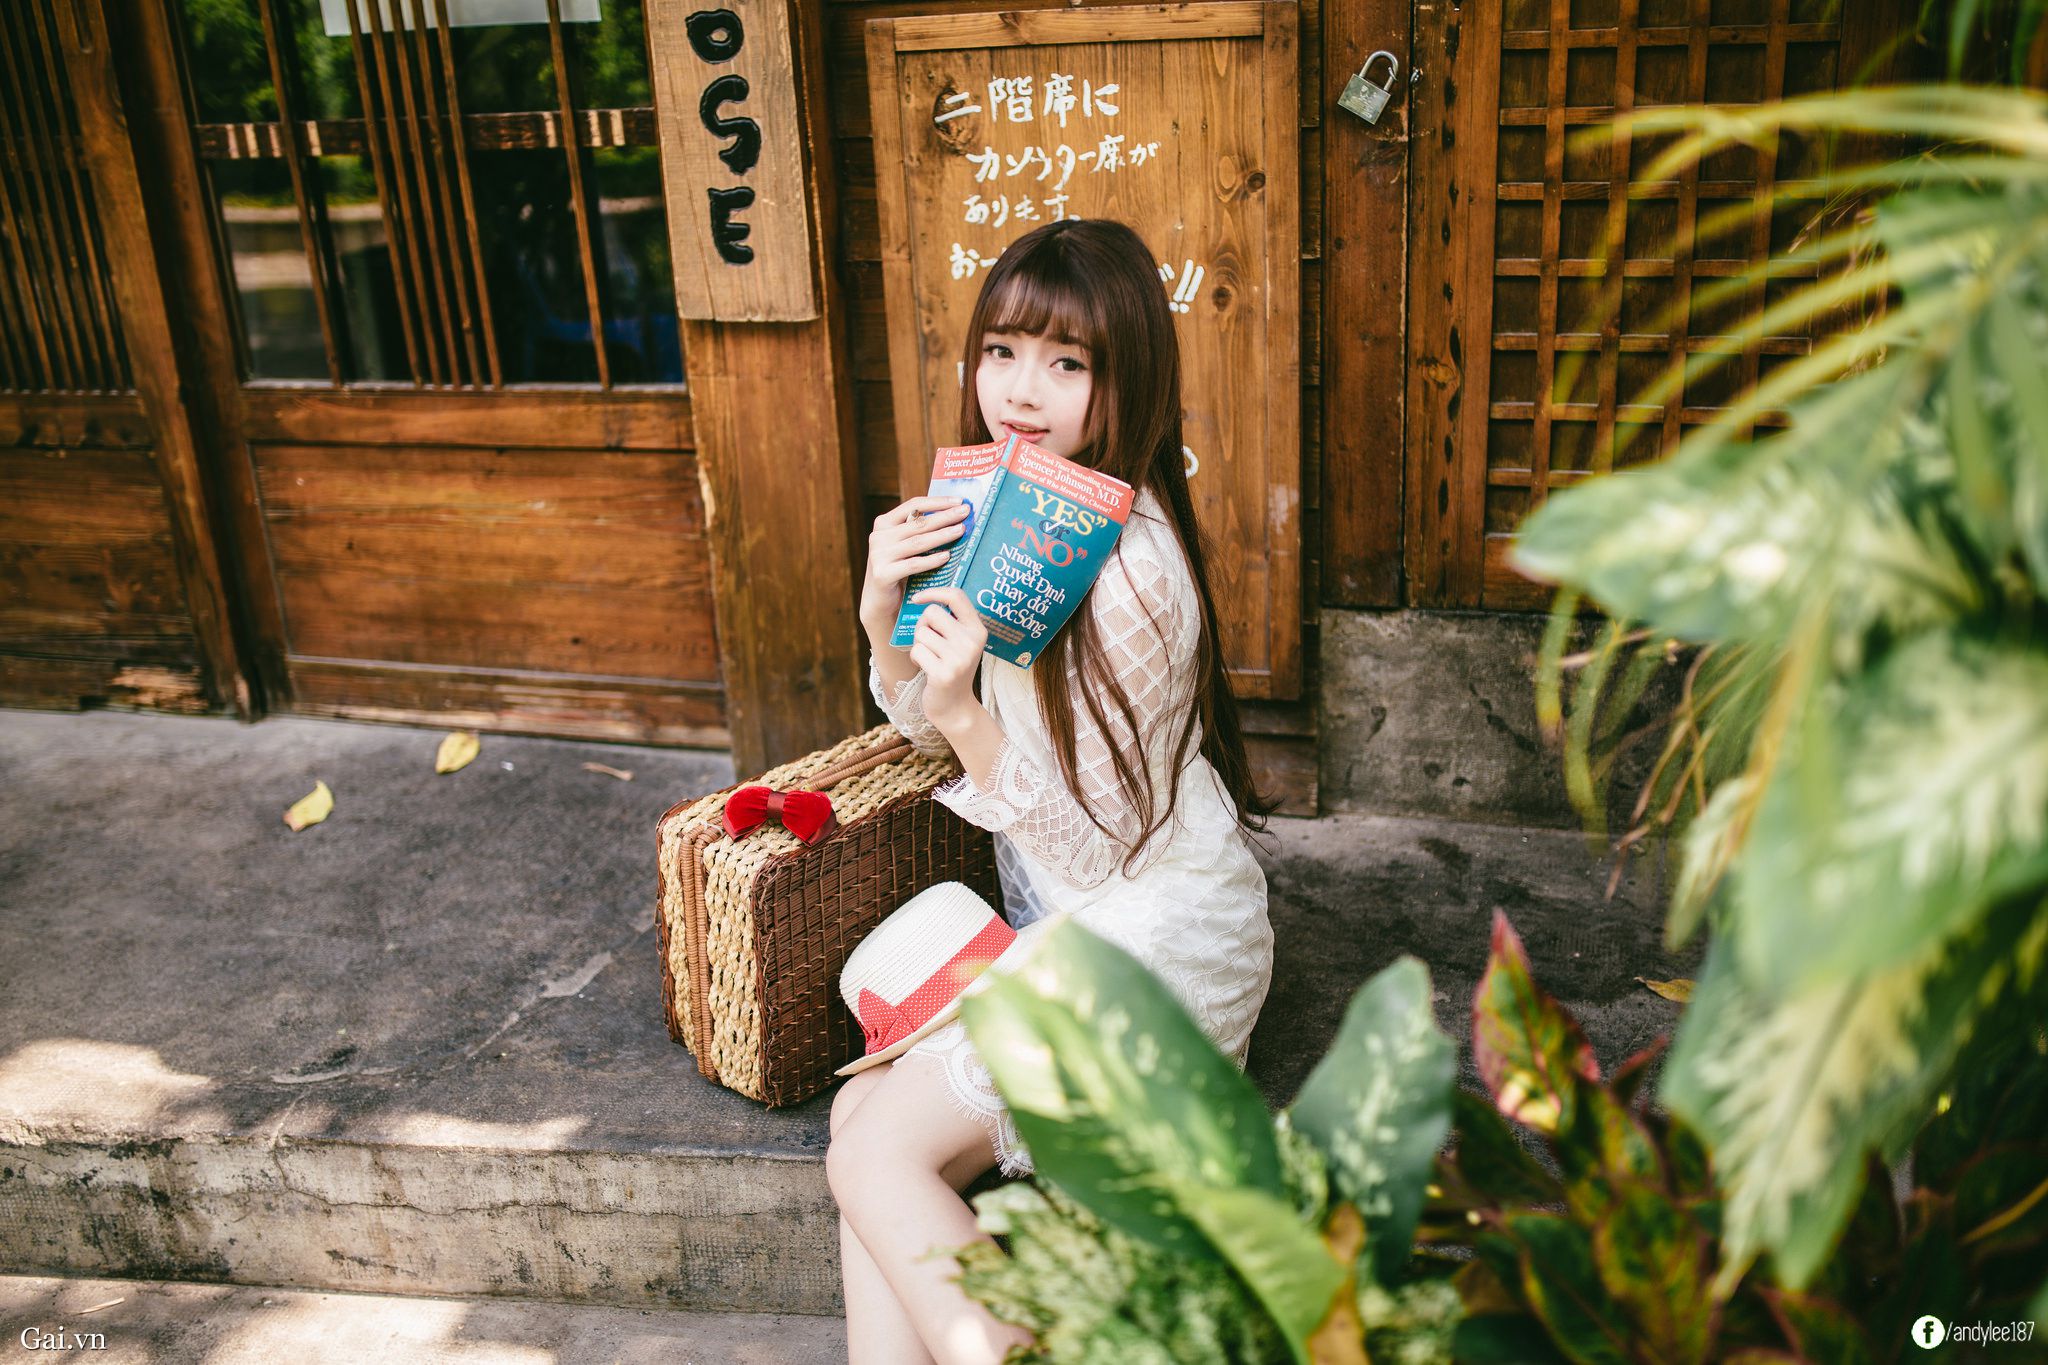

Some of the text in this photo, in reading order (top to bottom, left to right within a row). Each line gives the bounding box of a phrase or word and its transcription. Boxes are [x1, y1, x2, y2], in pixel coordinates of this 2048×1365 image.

[934, 73, 1120, 128] 二階席に
[1017, 467, 1040, 480] Author
[1046, 479, 1059, 490] Who
[1079, 493, 1090, 505] My
[1018, 453, 1055, 479] Spencer
[1055, 470, 1095, 497] Johnson,
[1097, 488, 1121, 509] M.D.
[1102, 483, 1124, 497] Author
[990, 556, 1036, 588] Quyết
[1035, 577, 1066, 605] Định
[999, 543, 1044, 576] Những
[976, 589, 1018, 621] Cuộc
[1013, 608, 1048, 639] Sống
[993, 576, 1028, 606] thay
[1027, 596, 1052, 616] đổi
